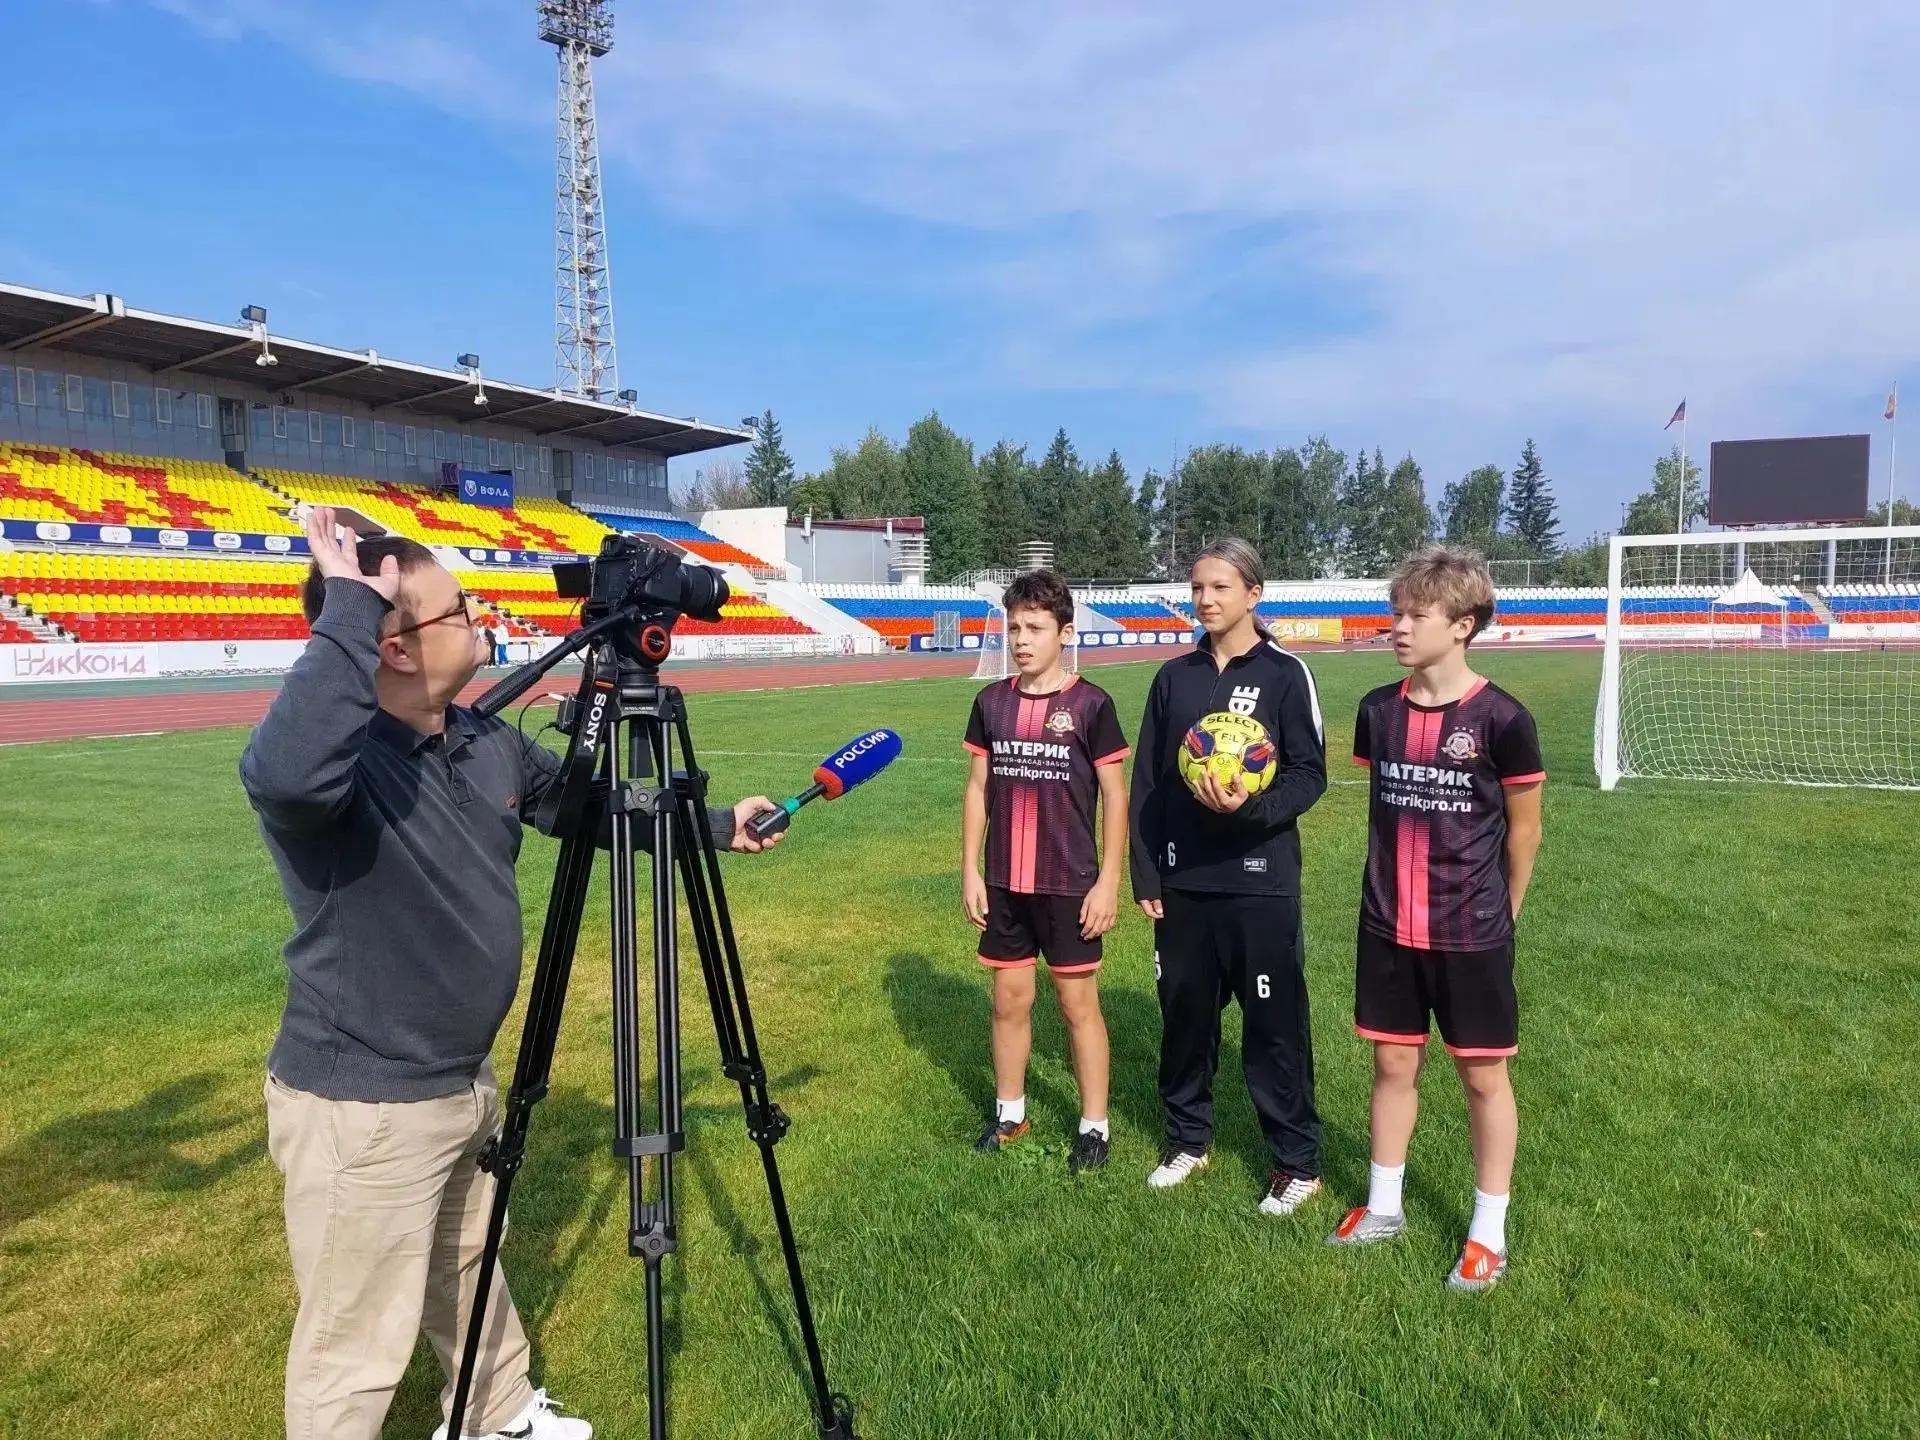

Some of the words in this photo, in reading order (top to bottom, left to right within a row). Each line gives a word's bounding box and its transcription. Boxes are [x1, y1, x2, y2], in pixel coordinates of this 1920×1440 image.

[1266, 621, 1320, 638] САРЫ
[583, 692, 607, 753] SONY
[1207, 715, 1259, 733] SELECT
[834, 730, 890, 769] РОССИЯ
[1167, 841, 1177, 867] 6
[1256, 974, 1271, 999] 6
